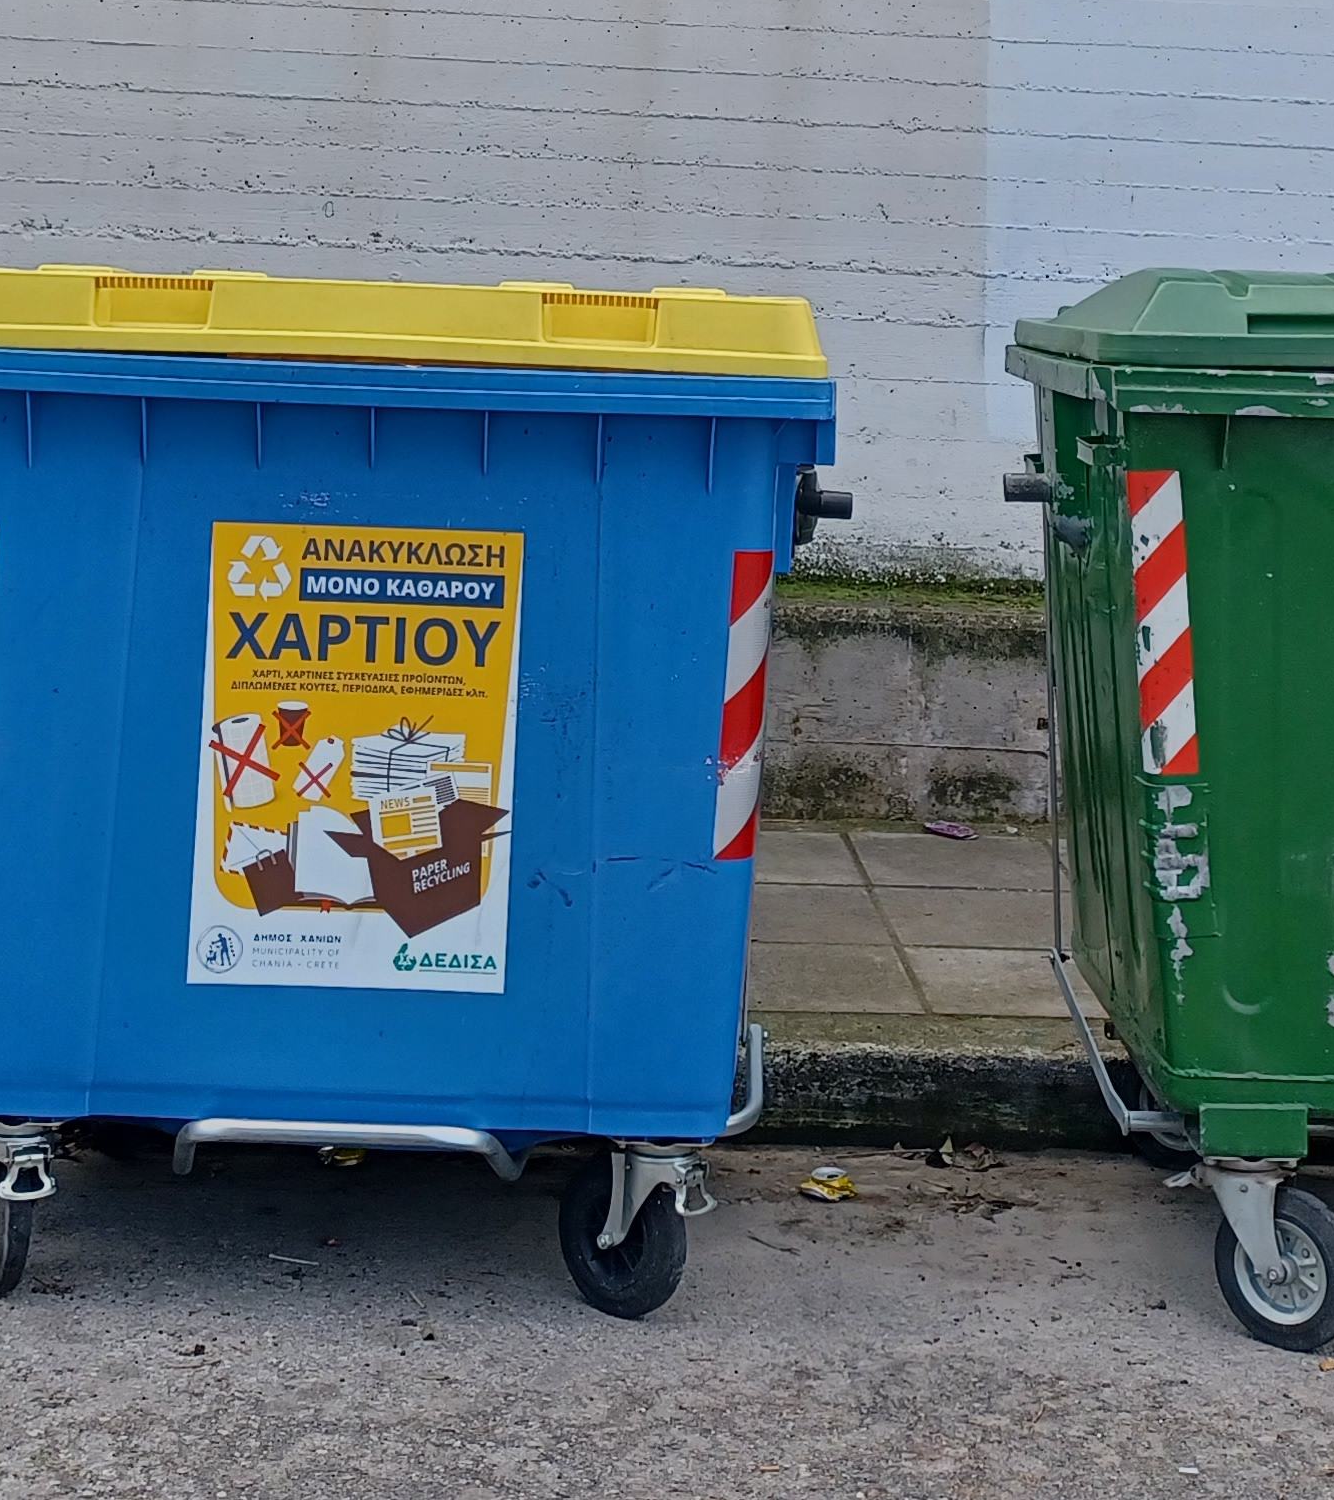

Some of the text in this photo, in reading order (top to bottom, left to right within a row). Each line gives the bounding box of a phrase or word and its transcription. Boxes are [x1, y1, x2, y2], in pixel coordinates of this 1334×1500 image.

[302, 538, 506, 568] ΑΝΑΚΥΚΛΩΣΗ
[306, 575, 496, 600] ΜΟΝΟ ΚΑΘΑΡΟΥ
[225, 611, 502, 668] ΧΑΡΤΙΟΥ
[252, 669, 284, 680] ΧΑΡΤΙ,
[285, 670, 334, 680] ΧΑΡΤΙΝΕΣ
[336, 671, 400, 682] ΣΥΣΚΕΥΑΣΙΕΣ
[230, 680, 298, 691] ΔΙΠΛΩΜΕΝΕΣ
[299, 682, 340, 693] ΚΟΥΤΕΣ,
[342, 684, 398, 695] ΠΕΡΙΟΔΙΚΑ,
[400, 685, 464, 697] ΕΦΗΜΕΡΙΔΕΣ
[380, 796, 411, 811] NEWS
[411, 858, 449, 882] PAPER
[413, 862, 471, 894] RECYCLING
[253, 933, 342, 944] ΔΗΜΟΣ ΧΑΝΙΩΝ
[252, 947, 340, 957] MUNICIPALITY OF
[251, 959, 293, 968] CHANIA
[306, 961, 339, 969] CRETE
[419, 952, 497, 970] ΔΕΔΙΣΑ
